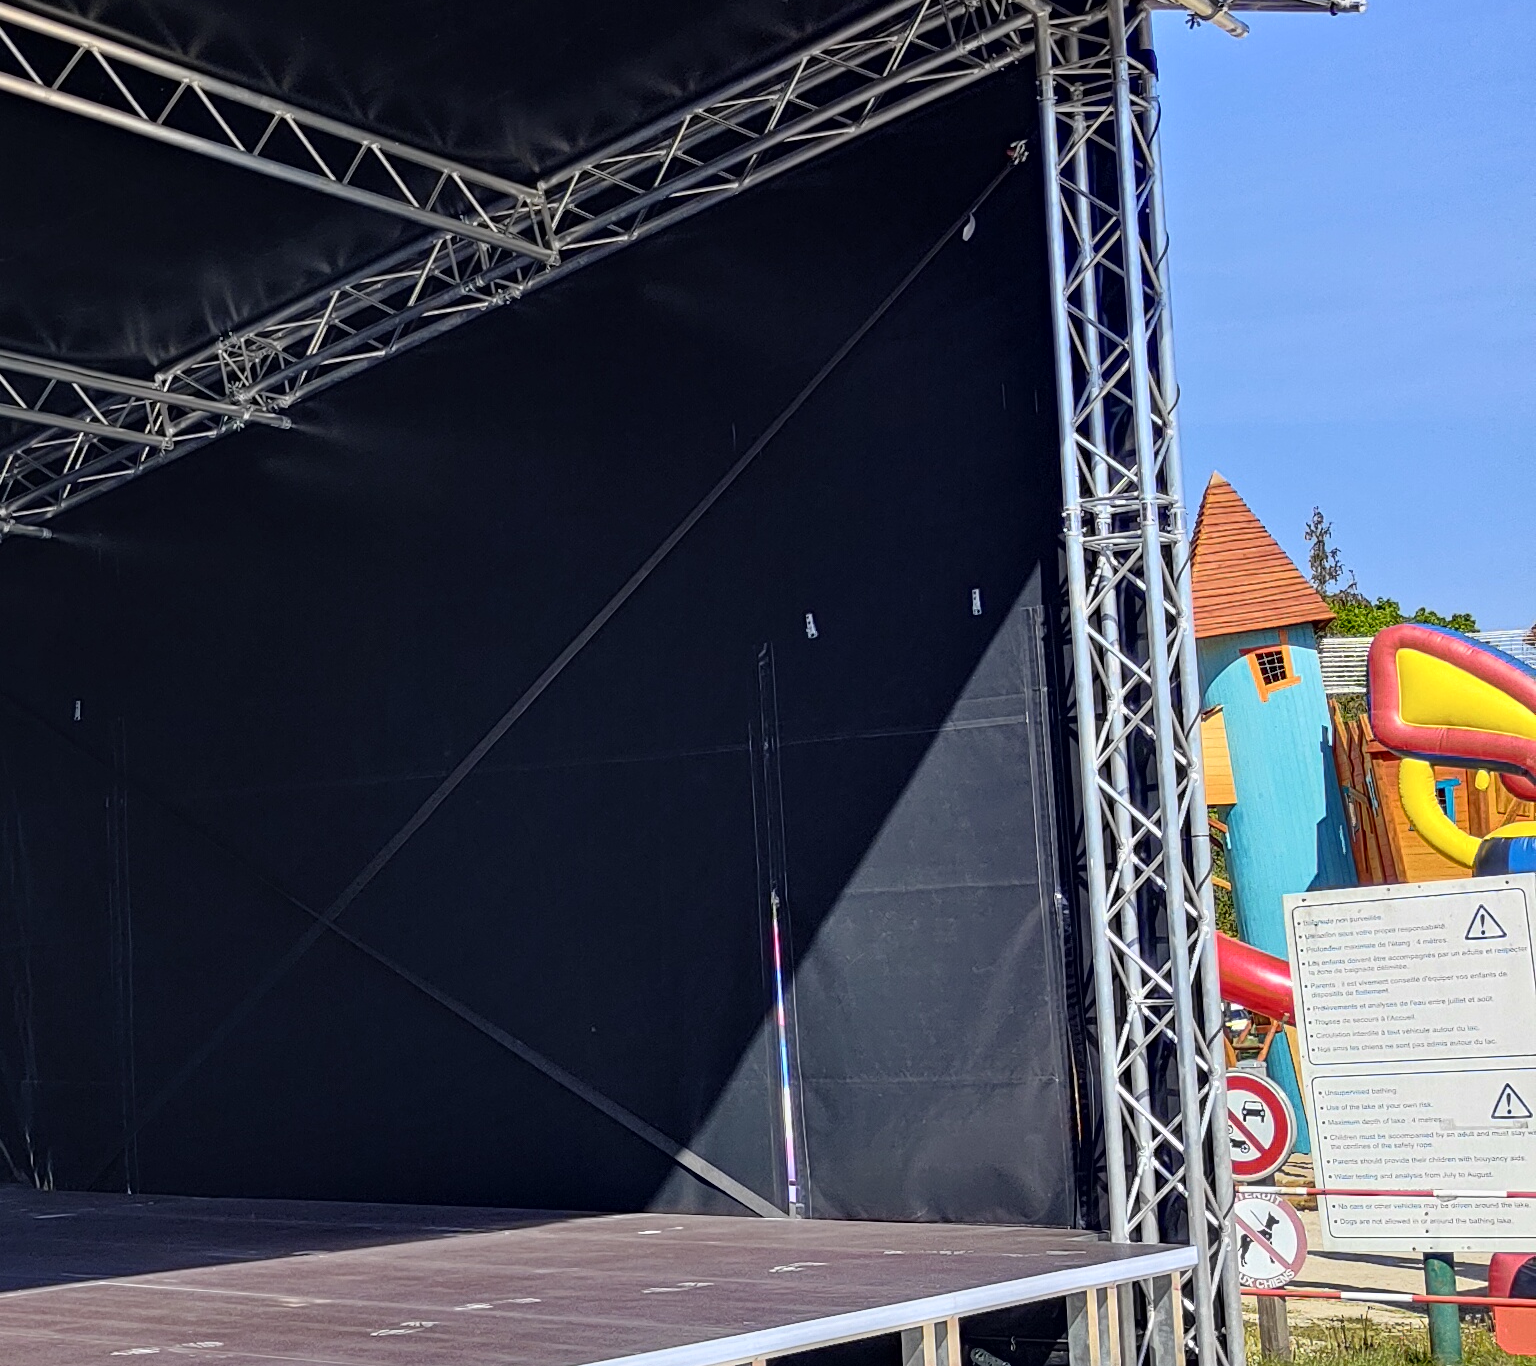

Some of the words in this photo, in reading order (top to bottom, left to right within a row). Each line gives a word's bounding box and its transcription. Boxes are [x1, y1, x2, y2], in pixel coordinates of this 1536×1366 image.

[1235, 1192, 1283, 1205] TERDIT
[1239, 1272, 1255, 1287] UX
[1255, 1268, 1295, 1289] CHIENS
